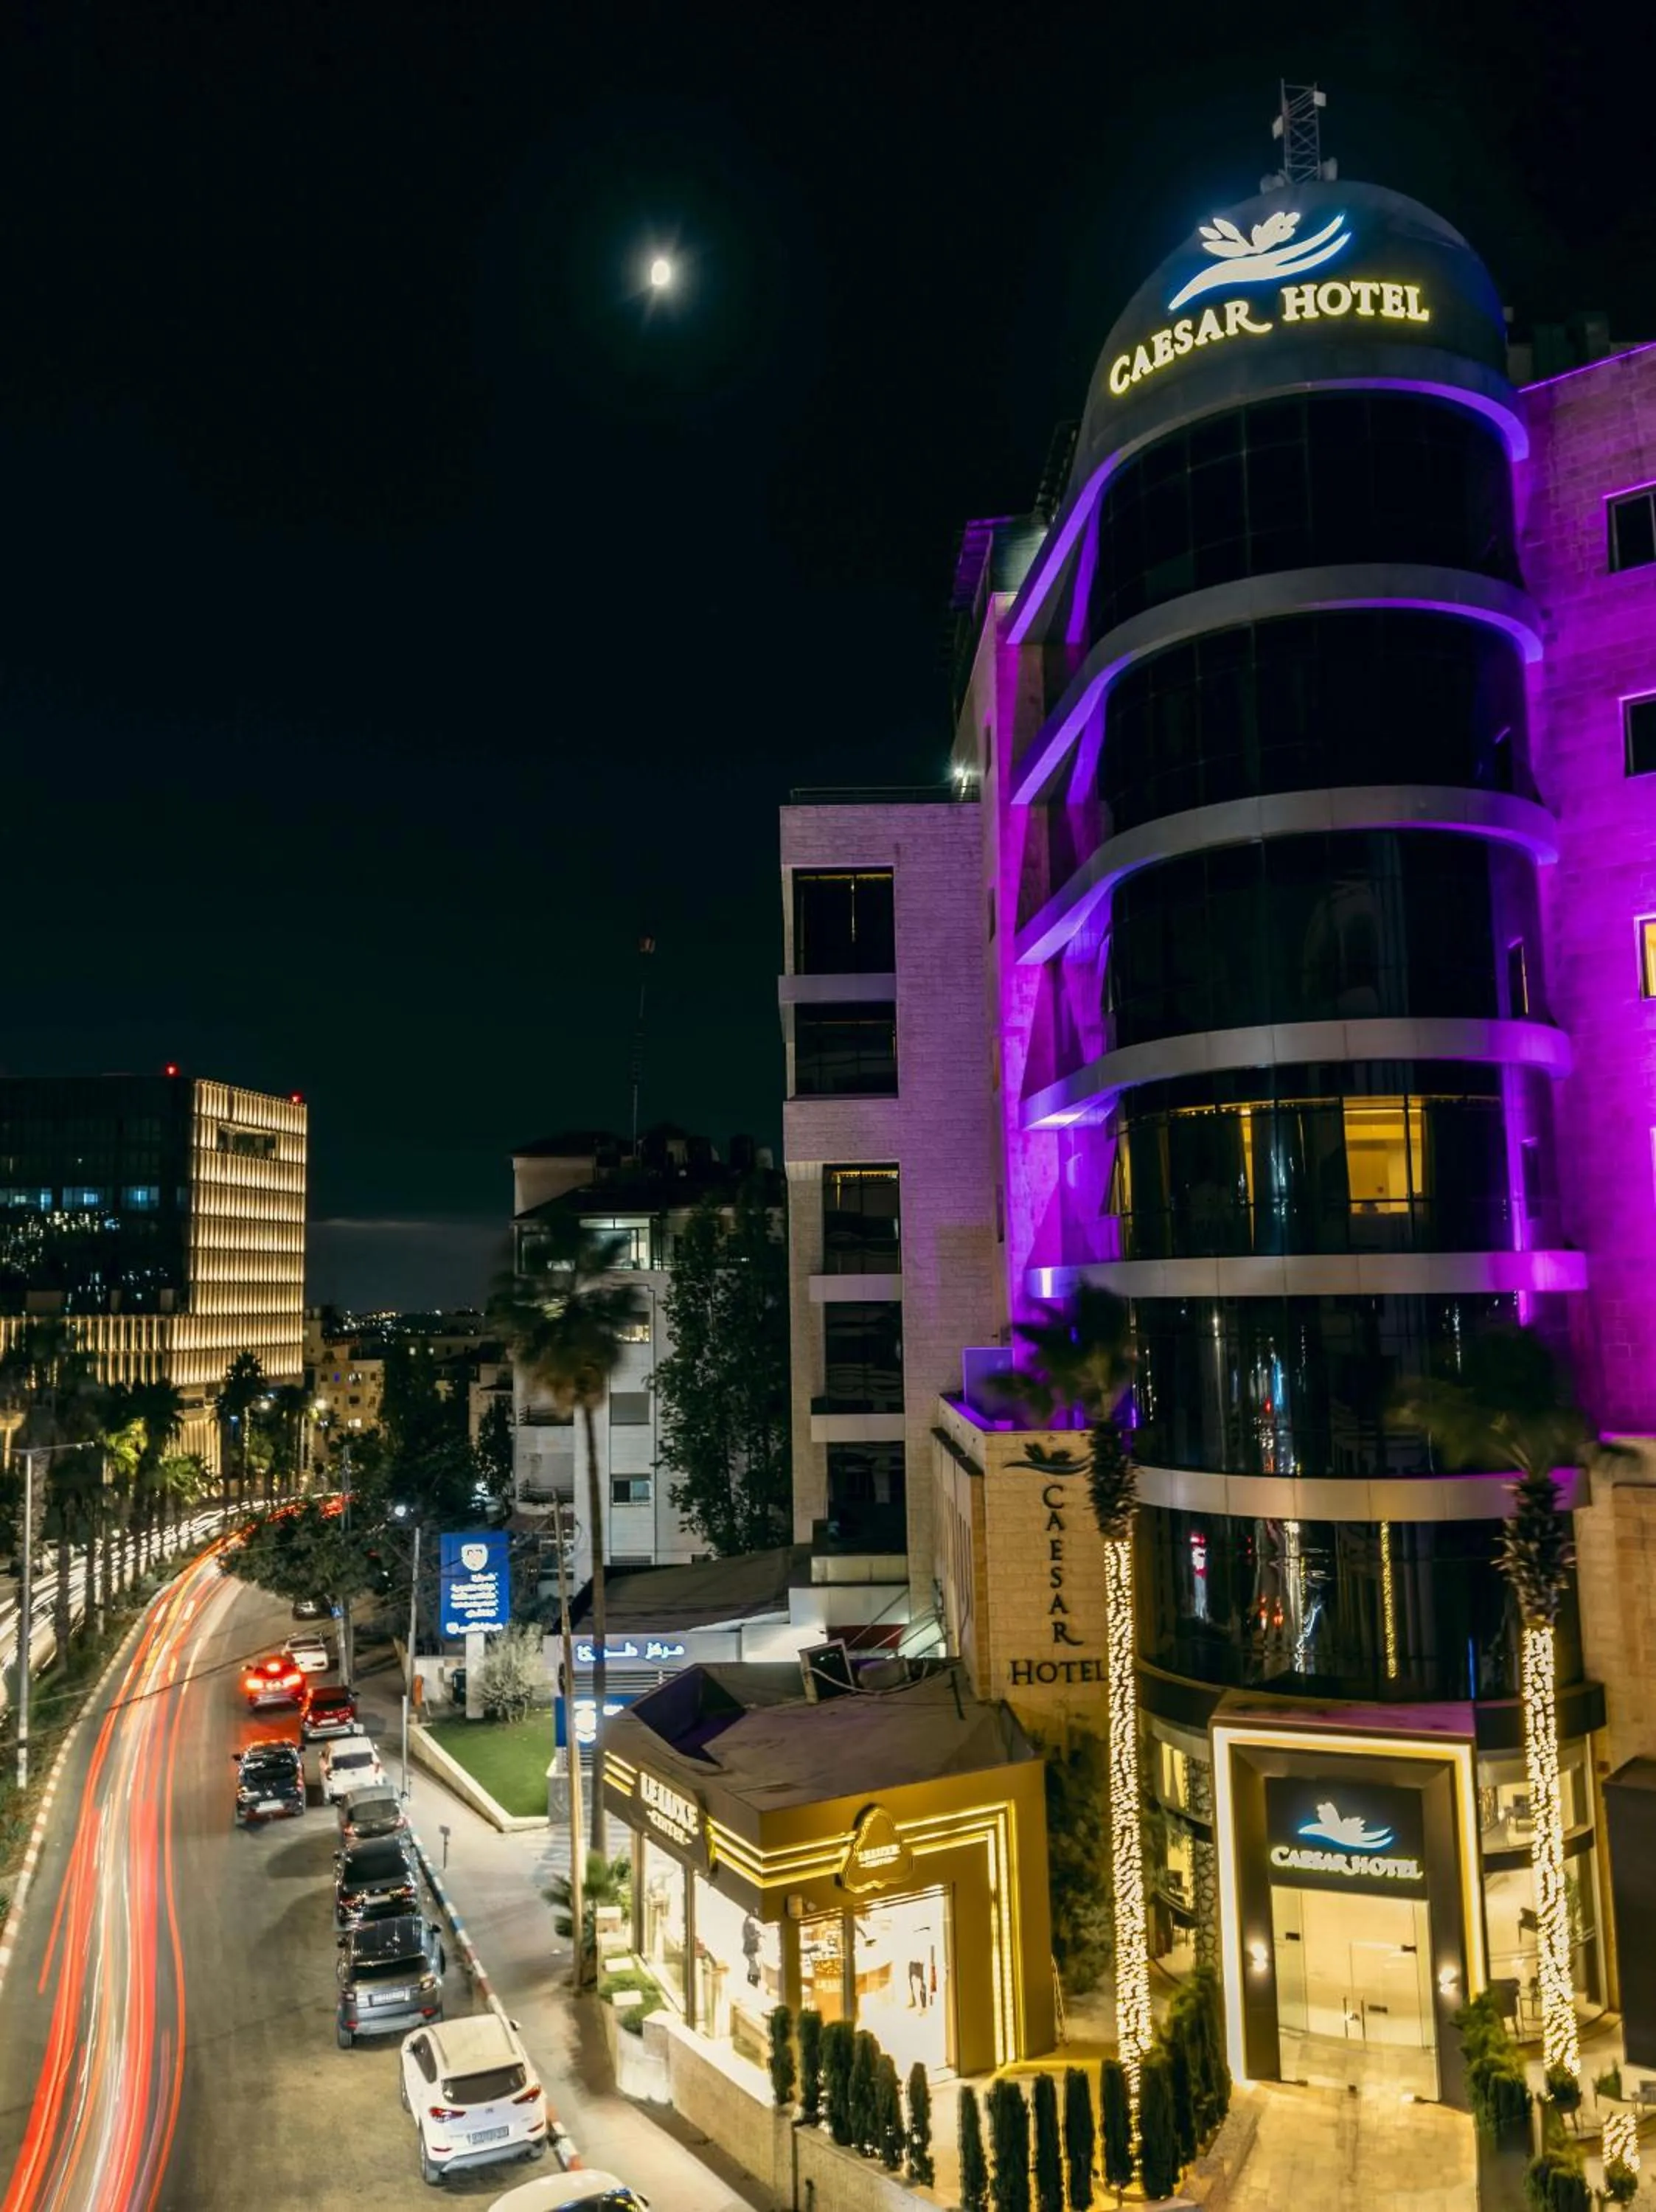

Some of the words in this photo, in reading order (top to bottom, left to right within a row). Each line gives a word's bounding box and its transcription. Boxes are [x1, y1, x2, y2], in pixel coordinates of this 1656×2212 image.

[1109, 300, 1273, 395] CAESAR
[1281, 280, 1430, 322] HOTEL
[1042, 1484, 1084, 1646] CAESAR
[1010, 1659, 1106, 1686] HOTEL
[1270, 1846, 1354, 1876] CAESAR
[1351, 1854, 1424, 1879] HOTEL
